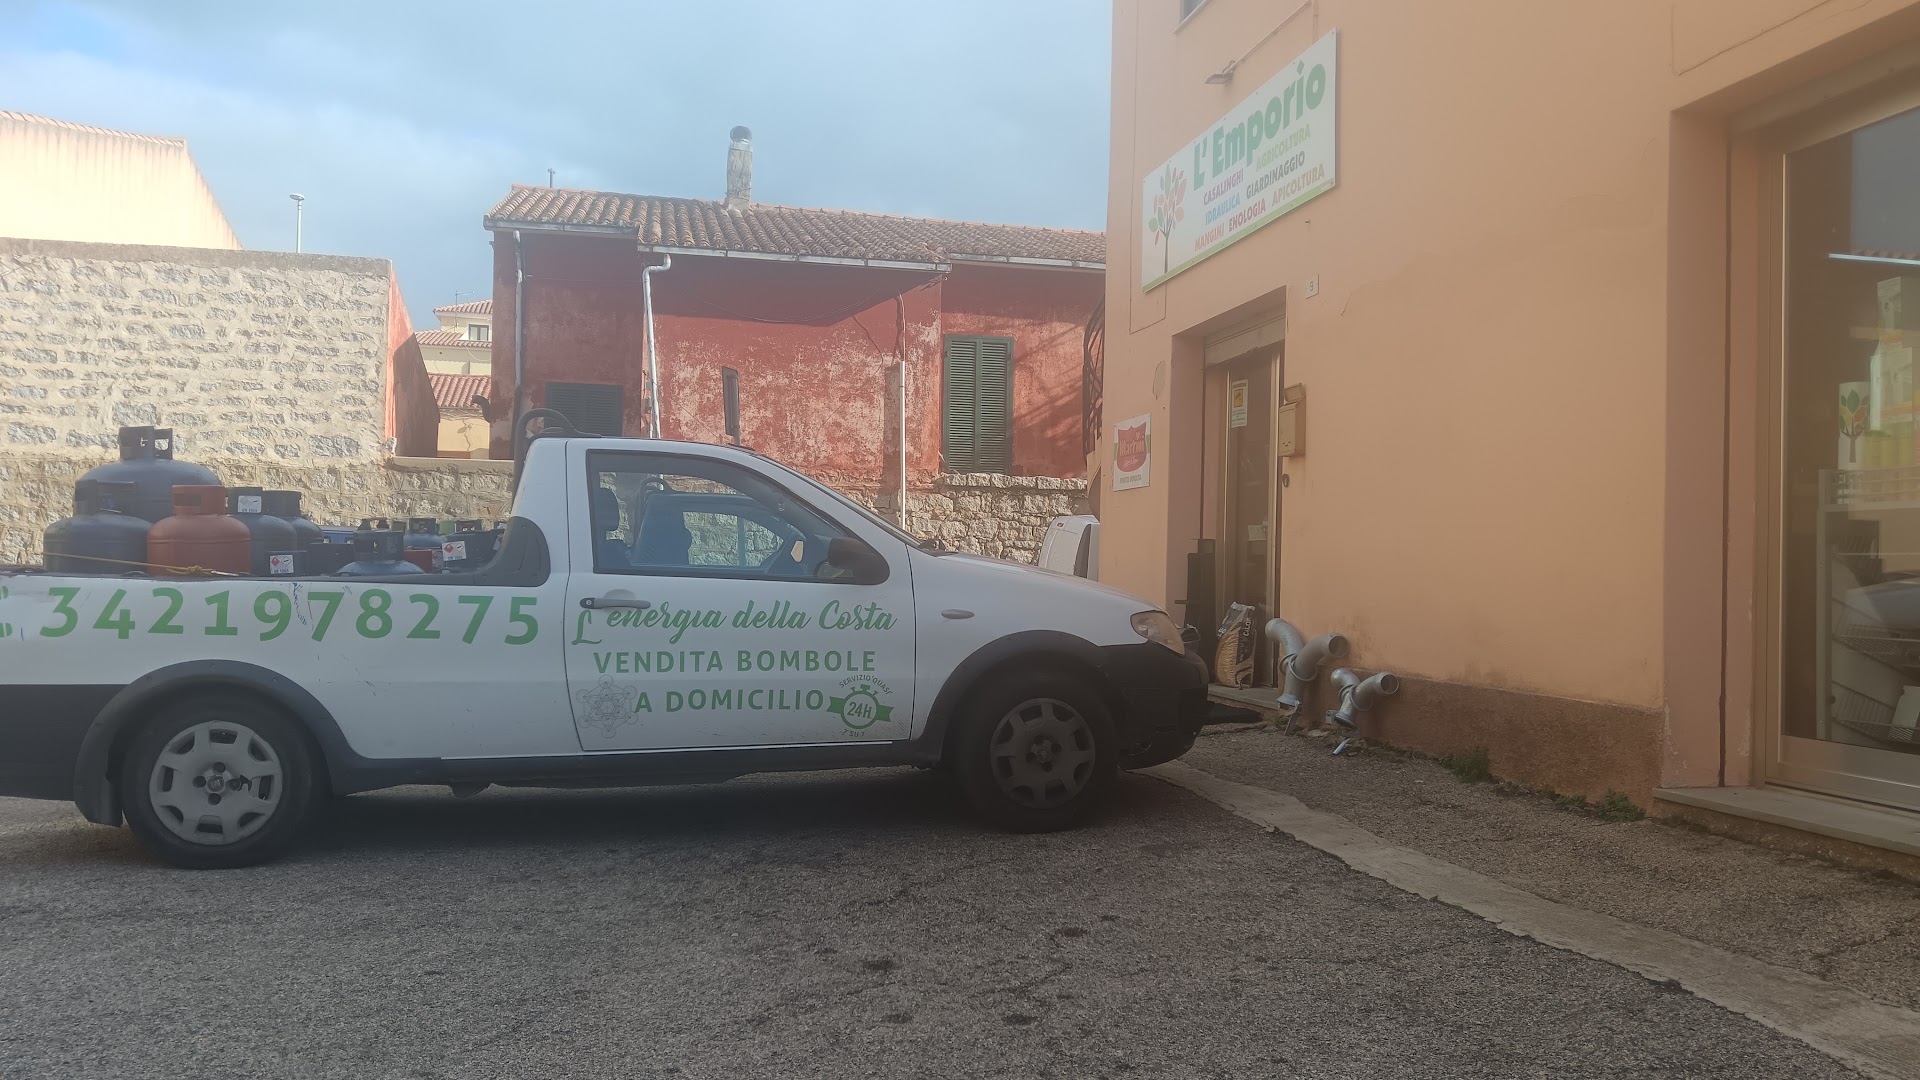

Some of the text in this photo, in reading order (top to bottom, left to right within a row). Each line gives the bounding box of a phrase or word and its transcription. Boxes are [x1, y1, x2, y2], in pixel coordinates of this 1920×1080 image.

[1256, 123, 1311, 172] AGRICOLTURA
[1203, 168, 1244, 206] CASALINGHI
[1246, 150, 1306, 199] GIARDINAGGIO
[1272, 163, 1325, 207] APICOLTURA
[1194, 198, 1266, 252] MANGIMI ENOLOGIA
[1205, 192, 1241, 226] IDRAULICA
[40, 587, 539, 646] 3421978275
[732, 600, 811, 630] della
[819, 600, 897, 630] Costa
[593, 650, 875, 673] VENDITA BOMBOLE
[839, 674, 871, 688] SERVIZIO
[633, 689, 824, 712] A DOMICILIO
[846, 702, 872, 719] 24H
